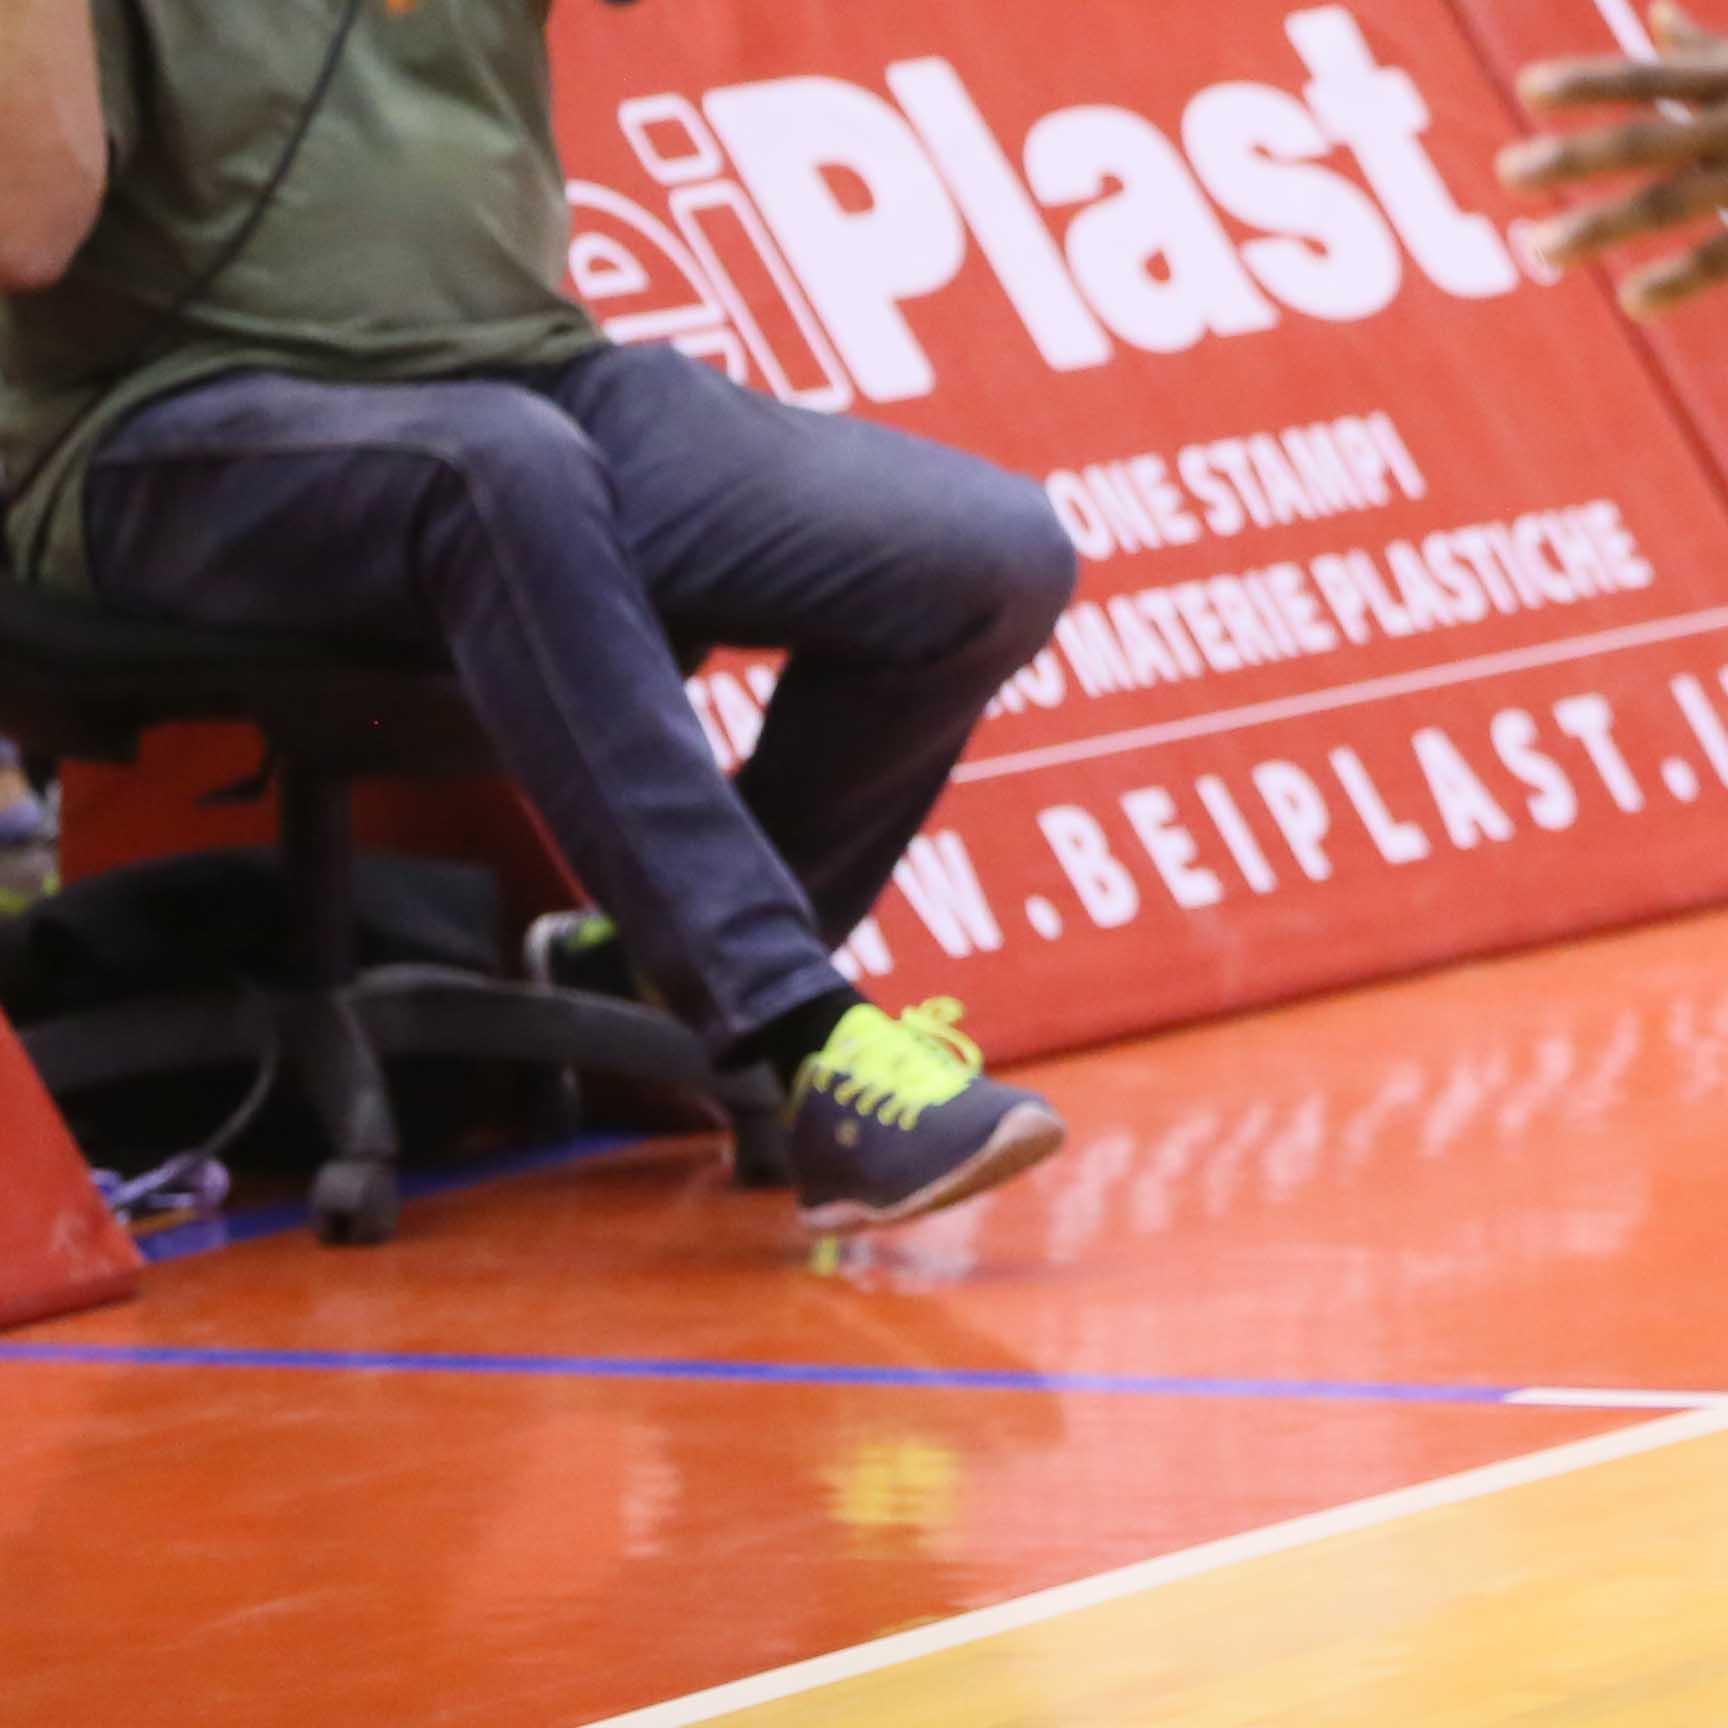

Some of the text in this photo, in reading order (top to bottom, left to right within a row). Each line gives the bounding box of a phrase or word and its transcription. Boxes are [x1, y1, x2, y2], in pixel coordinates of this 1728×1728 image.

[563, 3, 1520, 414] eiPlast
[1177, 408, 1428, 538] STAMPI
[1055, 499, 1656, 699] MATERIE PLASTICHE
